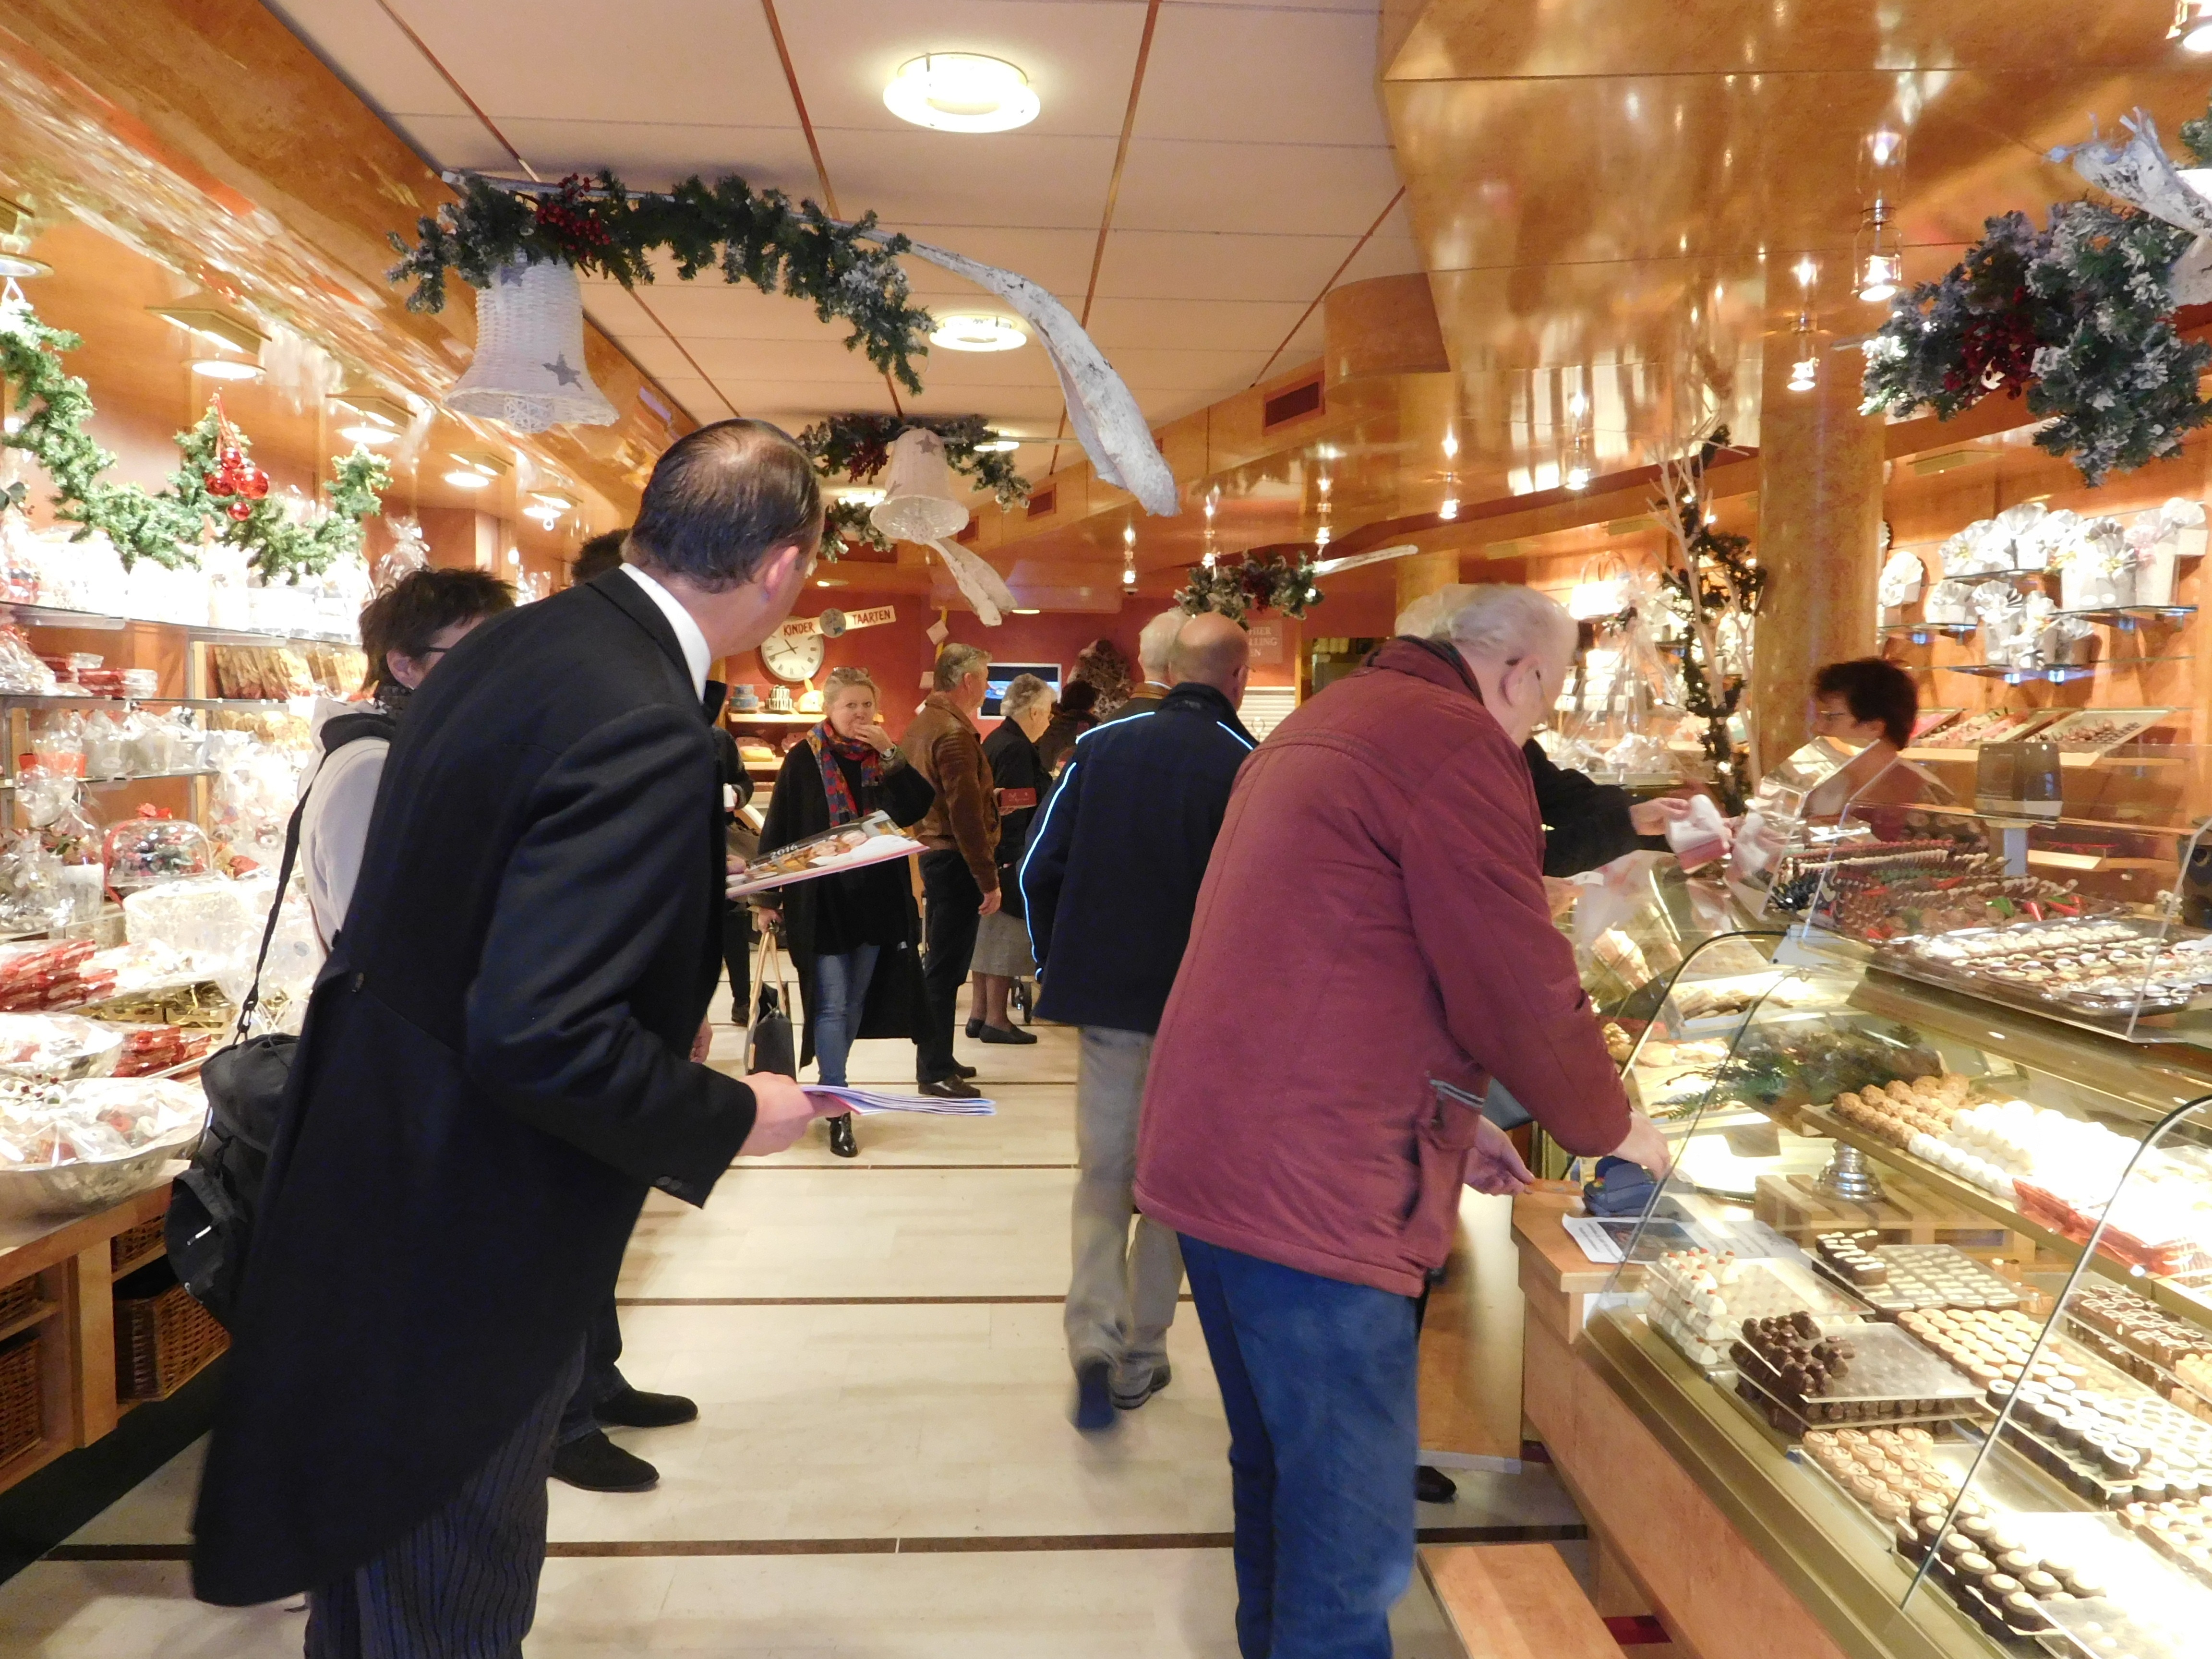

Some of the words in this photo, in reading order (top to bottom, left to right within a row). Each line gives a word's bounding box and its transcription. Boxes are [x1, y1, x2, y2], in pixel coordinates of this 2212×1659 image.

[783, 622, 815, 636] KINDER
[852, 610, 891, 625] TAARTEN
[770, 843, 798, 858] 2016
